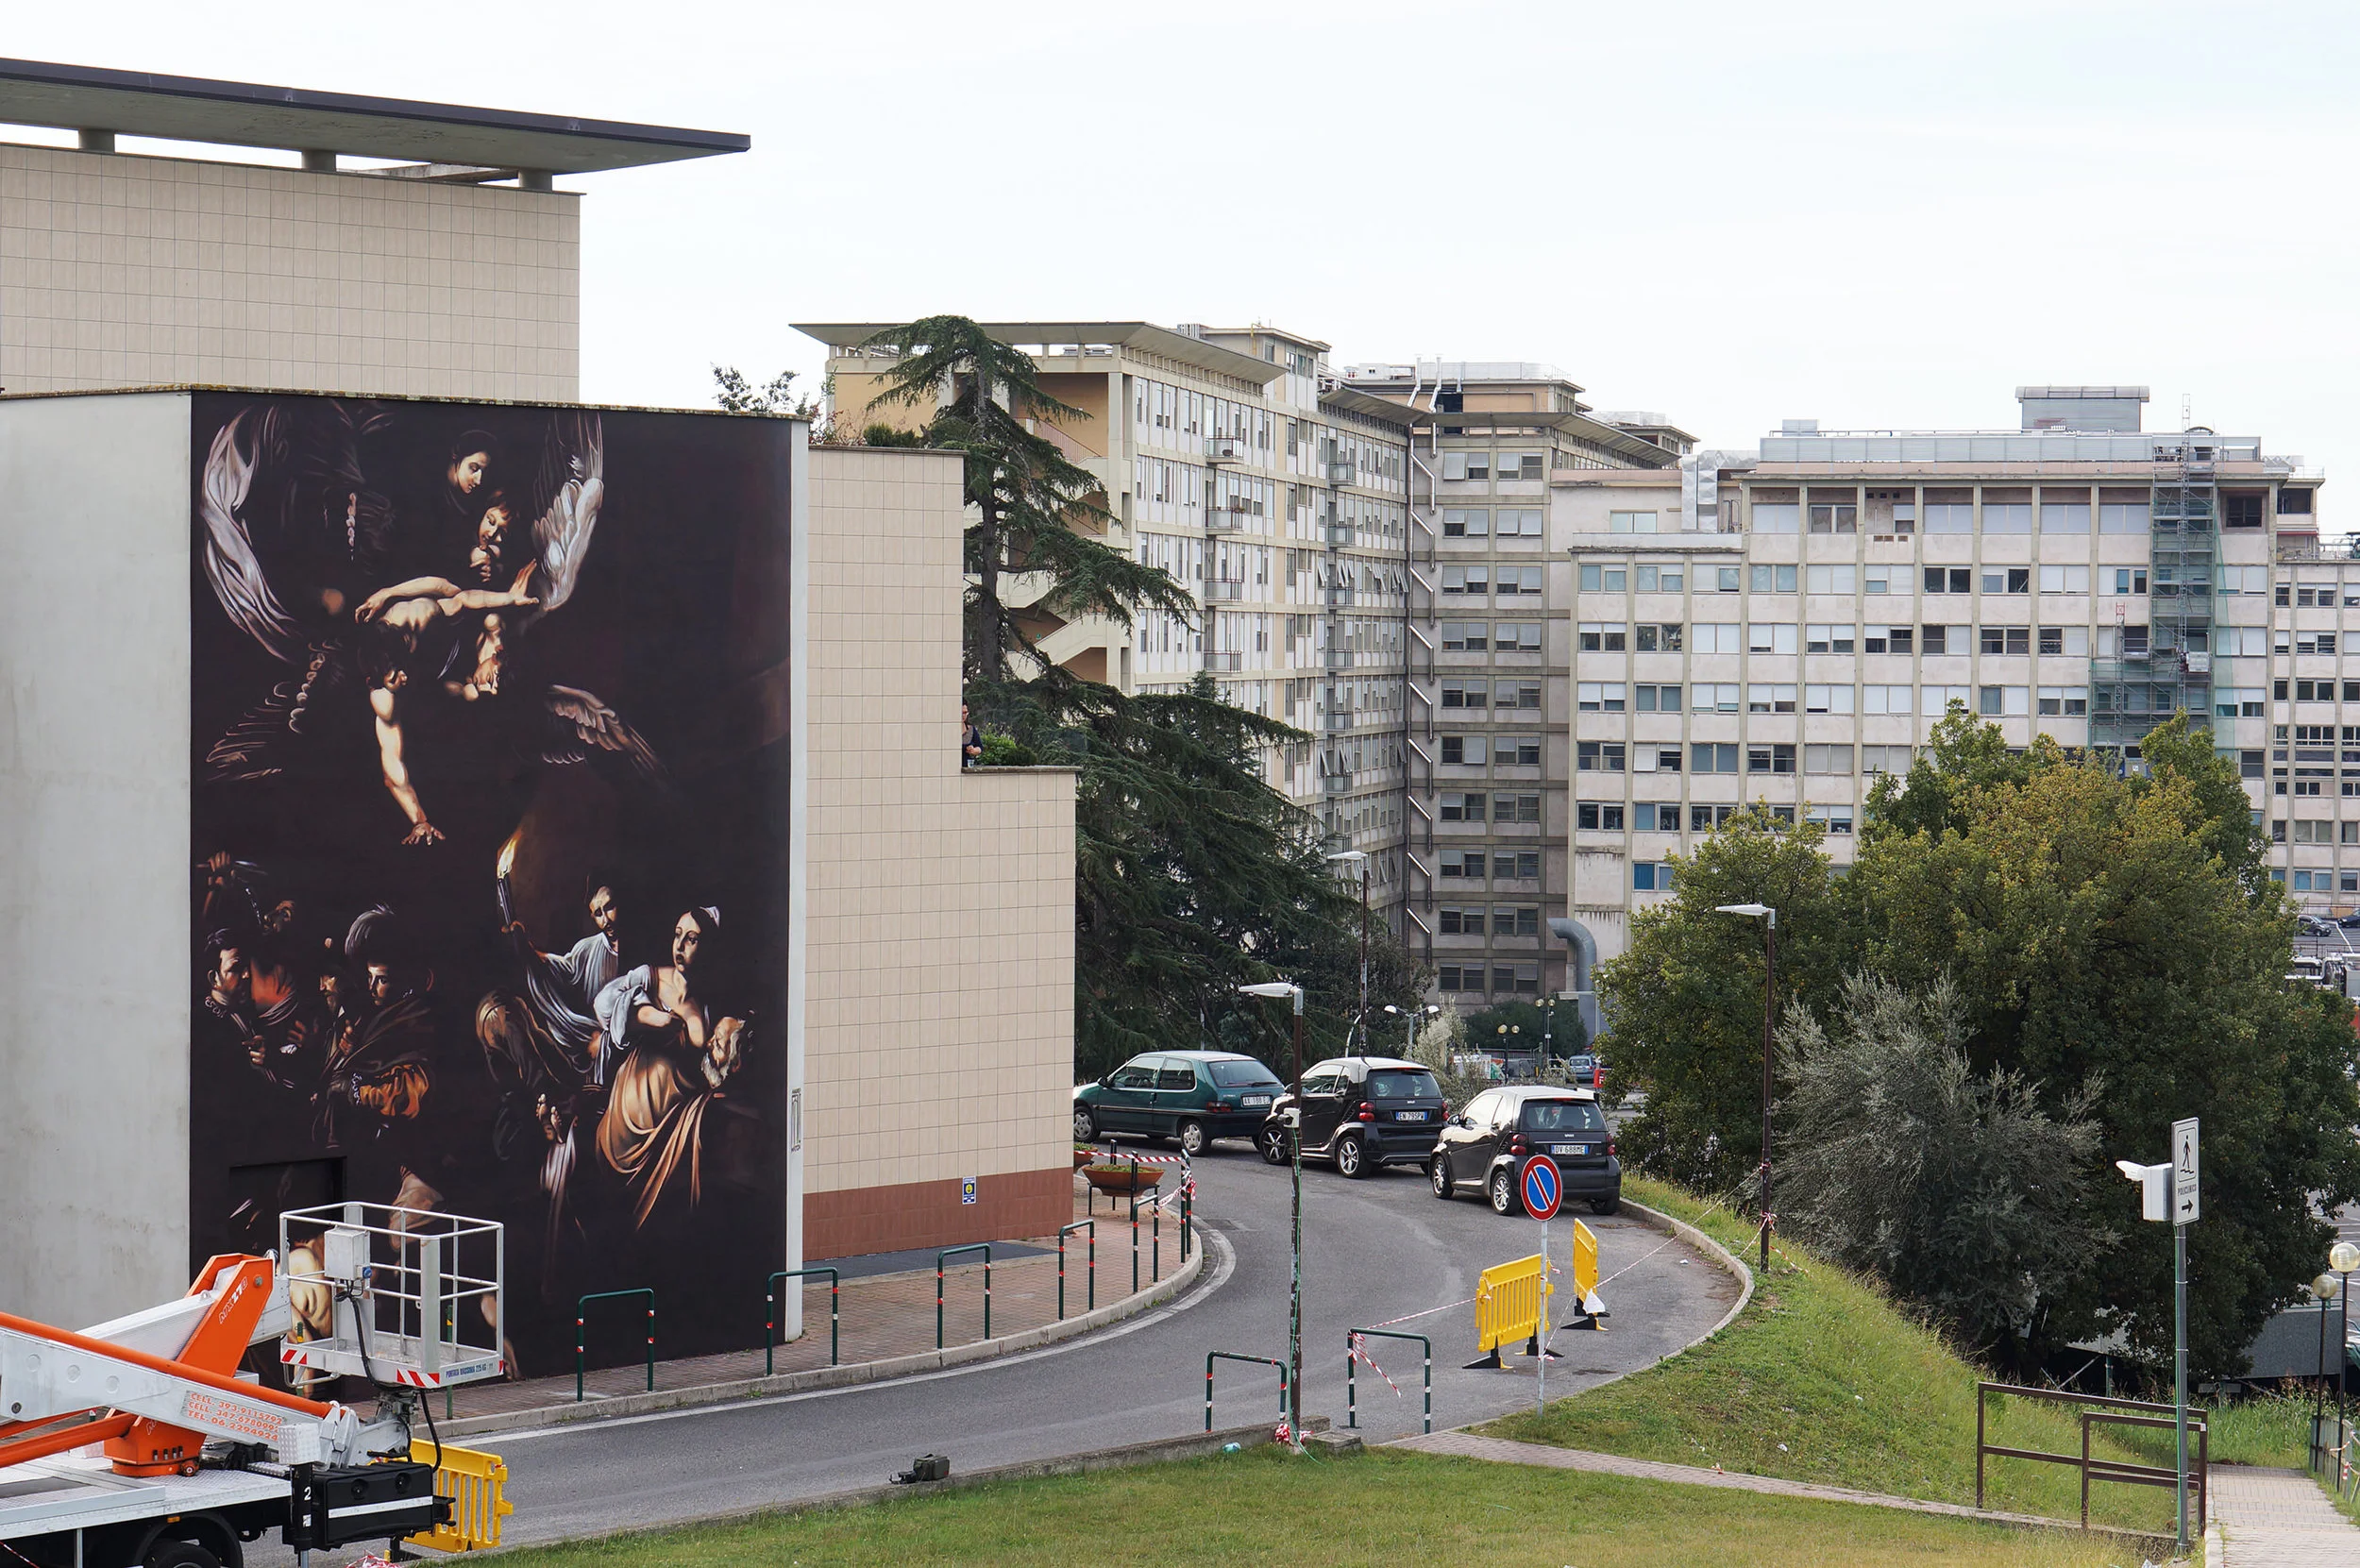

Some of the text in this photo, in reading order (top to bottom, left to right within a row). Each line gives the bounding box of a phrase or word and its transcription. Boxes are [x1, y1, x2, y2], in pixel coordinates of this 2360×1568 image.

[188, 1401, 212, 1414] CELL.
[191, 1392, 282, 1425] CELL. 393.9115792
[188, 1409, 210, 1422] TEL.
[304, 1486, 312, 1501] 2
